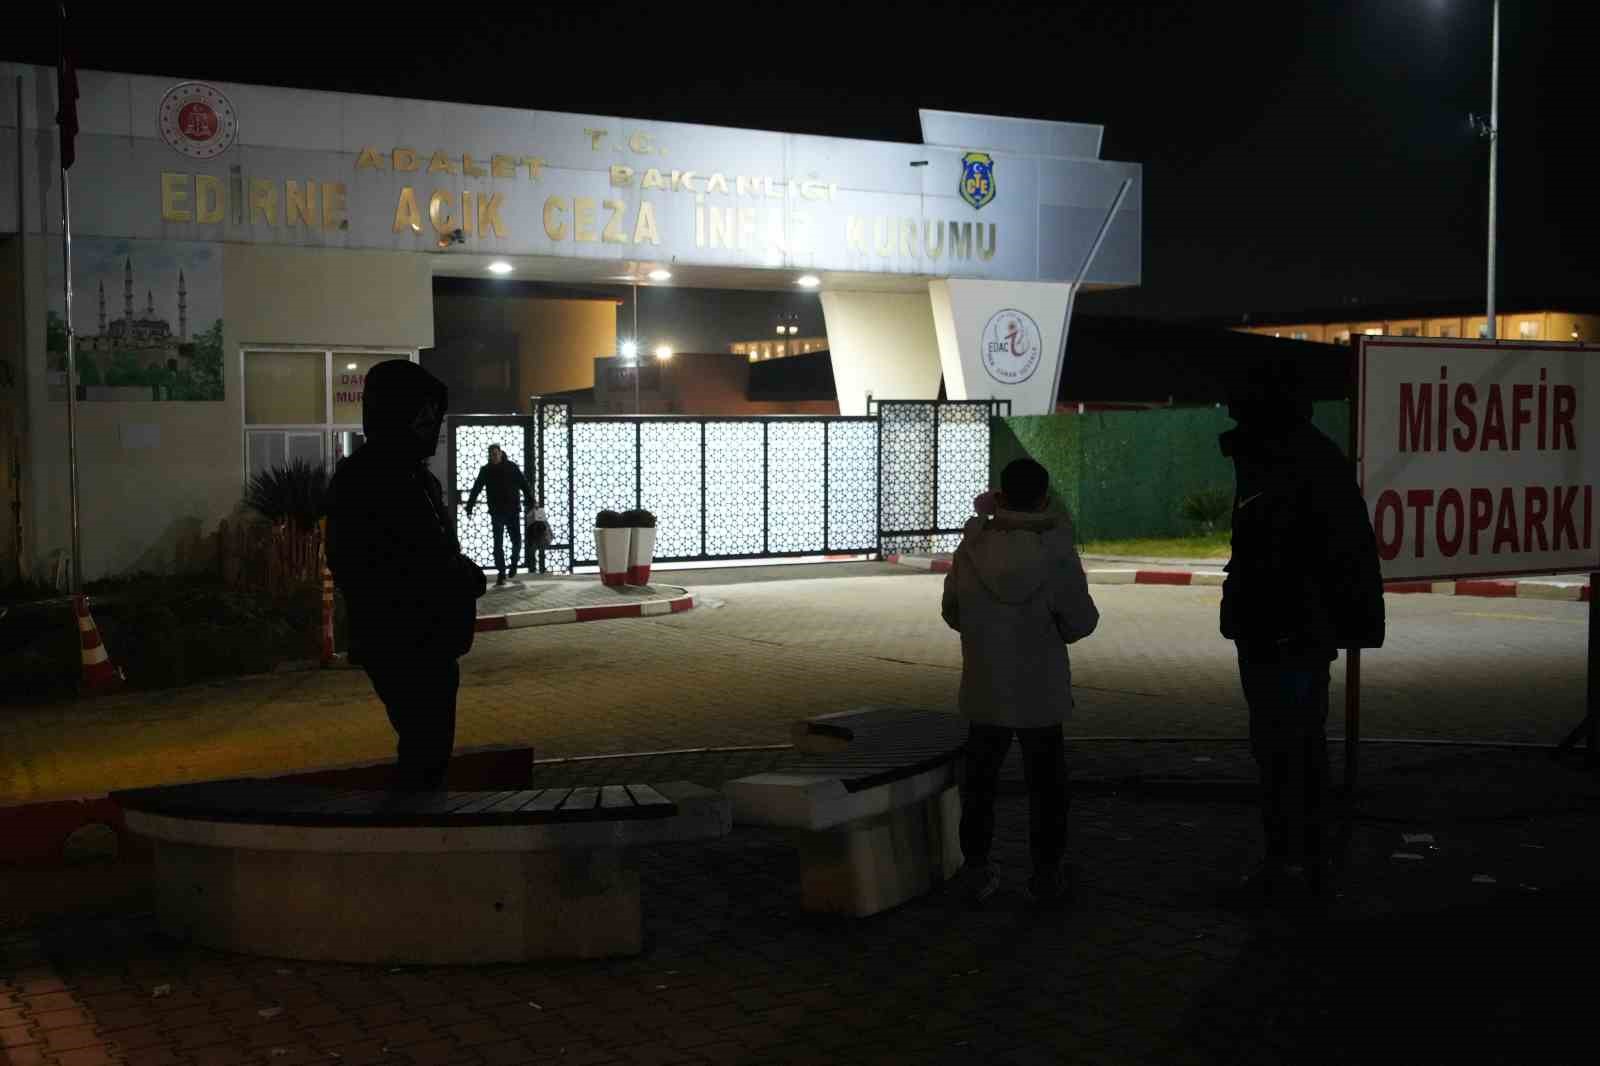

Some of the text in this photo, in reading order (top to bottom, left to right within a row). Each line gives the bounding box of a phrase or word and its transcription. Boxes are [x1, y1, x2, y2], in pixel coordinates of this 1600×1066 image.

[355, 146, 546, 181] ADALET
[161, 165, 347, 230] EDİRNE
[543, 194, 660, 245] CEZA
[1398, 366, 1577, 452] MİSAFİR
[1374, 485, 1593, 560] OTOPARKI
